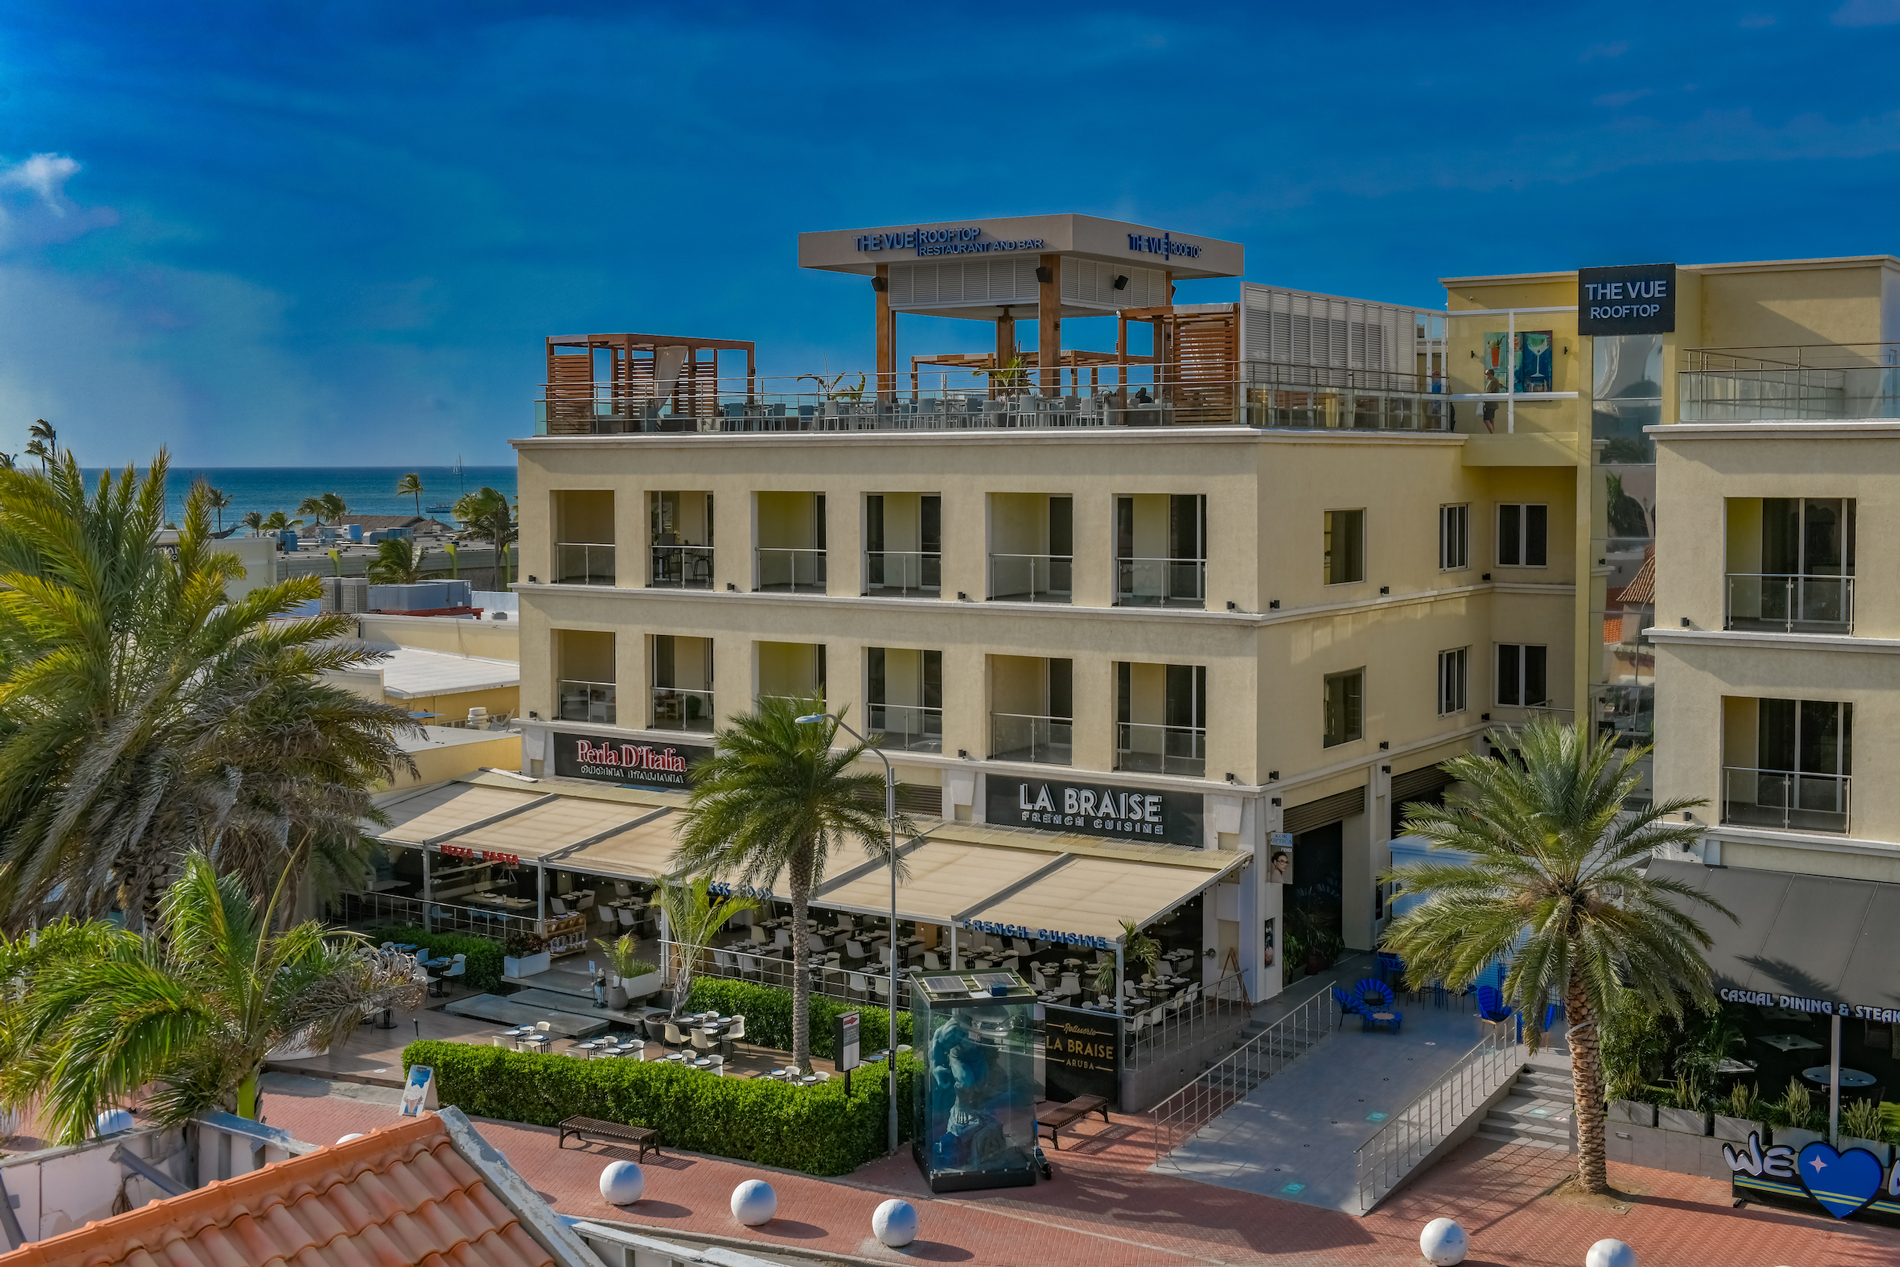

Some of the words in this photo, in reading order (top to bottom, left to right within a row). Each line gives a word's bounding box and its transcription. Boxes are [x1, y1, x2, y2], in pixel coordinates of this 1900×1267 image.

[852, 234, 882, 252] THE
[884, 231, 916, 250] VUE
[918, 227, 981, 244] ROOFTOP
[1128, 234, 1149, 253] THE
[1148, 236, 1168, 255] VUE
[918, 241, 991, 256] RESTAURANT
[992, 240, 1017, 252] AND
[1018, 238, 1045, 250] BAR
[1169, 240, 1203, 258] ROOFTOP
[1585, 282, 1623, 300] THE
[1626, 280, 1667, 298] VUE
[1590, 303, 1660, 319] ROOFTOP
[576, 739, 620, 766] Perla
[620, 743, 688, 773] D'Italia
[1020, 783, 1056, 812] LA
[1065, 787, 1163, 823] BRAISE
[1021, 811, 1085, 827] FRENCH
[1093, 818, 1164, 835] CUISINE
[963, 917, 1027, 939] FRENCH
[1037, 928, 1107, 949] CUISINE
[1720, 988, 1774, 1008] CASUAL
[1779, 995, 1833, 1015] DINING
[1838, 1003, 1849, 1017] &
[1046, 1035, 1064, 1051] LA
[1068, 1039, 1114, 1060] BRAISE
[1065, 1058, 1095, 1071] ARUBA
